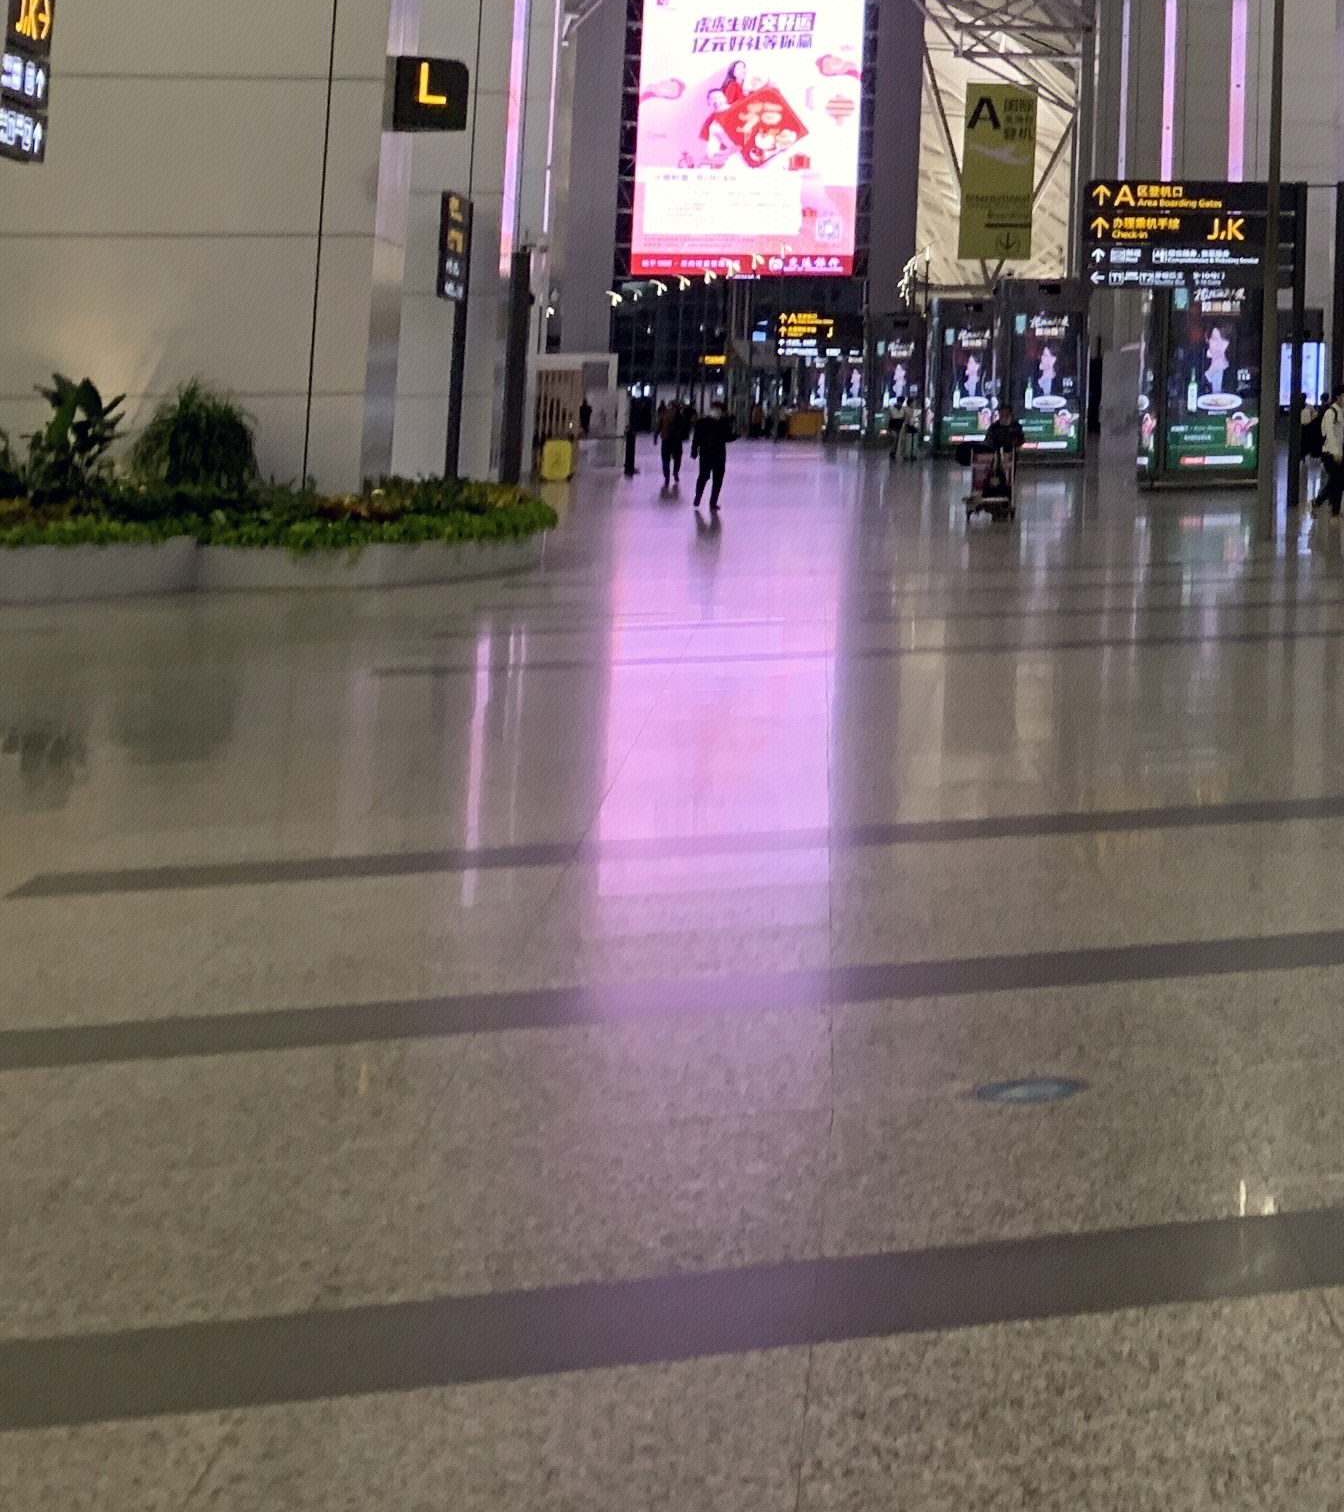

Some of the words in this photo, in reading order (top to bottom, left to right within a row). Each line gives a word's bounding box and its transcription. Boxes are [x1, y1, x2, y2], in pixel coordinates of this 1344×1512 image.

[419, 62, 447, 104] L
[967, 97, 1001, 129] A
[1113, 185, 1135, 206] A
[1137, 185, 1183, 198] 区登机口
[1137, 198, 1158, 208] Area
[1159, 199, 1197, 209] Boarding
[1198, 199, 1222, 209] Gates
[1111, 231, 1149, 239] Check-in
